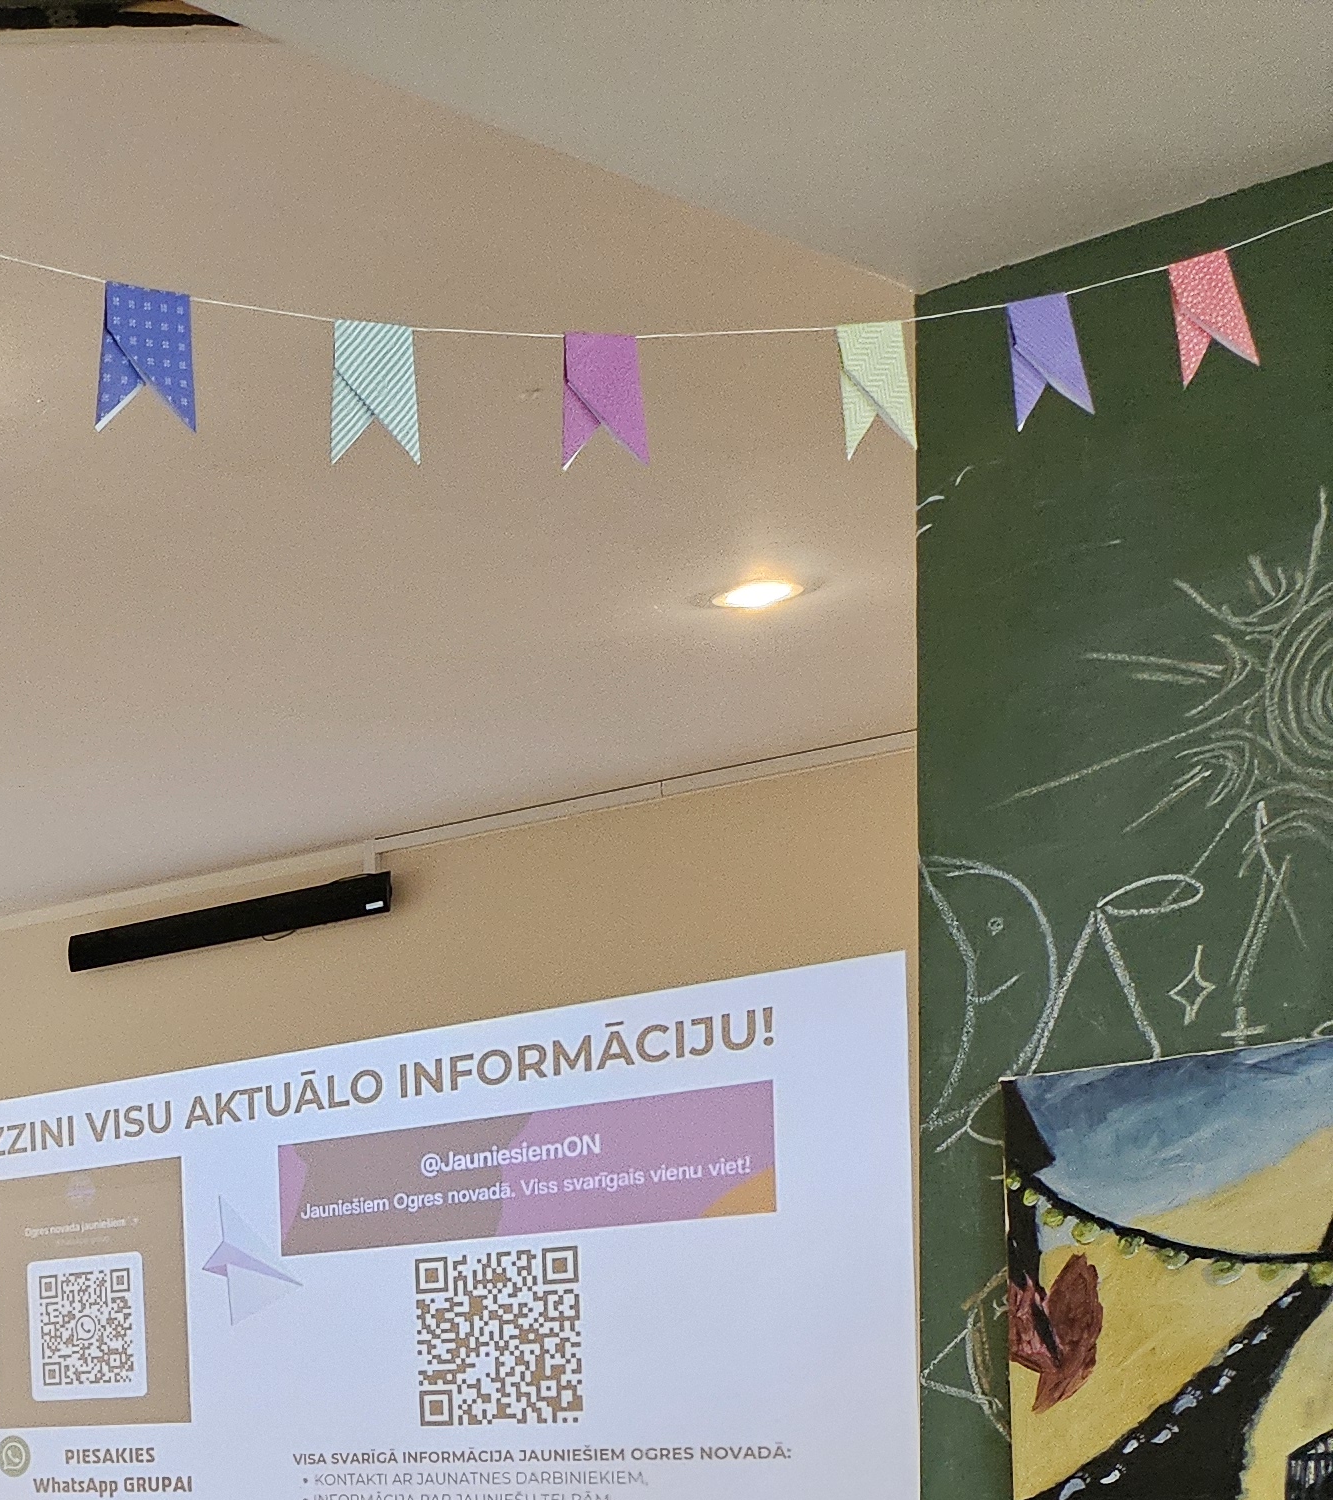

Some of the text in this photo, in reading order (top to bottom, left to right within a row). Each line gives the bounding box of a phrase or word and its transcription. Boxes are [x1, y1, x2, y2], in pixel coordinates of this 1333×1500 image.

[85, 1101, 173, 1143] VISU
[184, 1068, 383, 1130] AKTUĀLO
[399, 1006, 775, 1098] INFORMĀCIJU!
[421, 1133, 602, 1178] @JauniesiemON
[300, 1194, 390, 1220] Jauniešiem
[393, 1189, 444, 1215] Ogres
[447, 1181, 516, 1205] novadā.
[521, 1178, 559, 1196] Viss
[563, 1168, 645, 1193] svarīgais
[649, 1164, 702, 1182] vienu
[64, 1447, 156, 1465] PIESAKIES
[292, 1441, 792, 1466] VISA SVARĪGĀ INFORMĀCIJA JAUNIEŠIEM OGRES NOVADĀ:
[32, 1476, 119, 1498] WhatsApp
[314, 1470, 649, 1487] KONTAKTI AR JAUNATNES DARBINIEKIEM,
